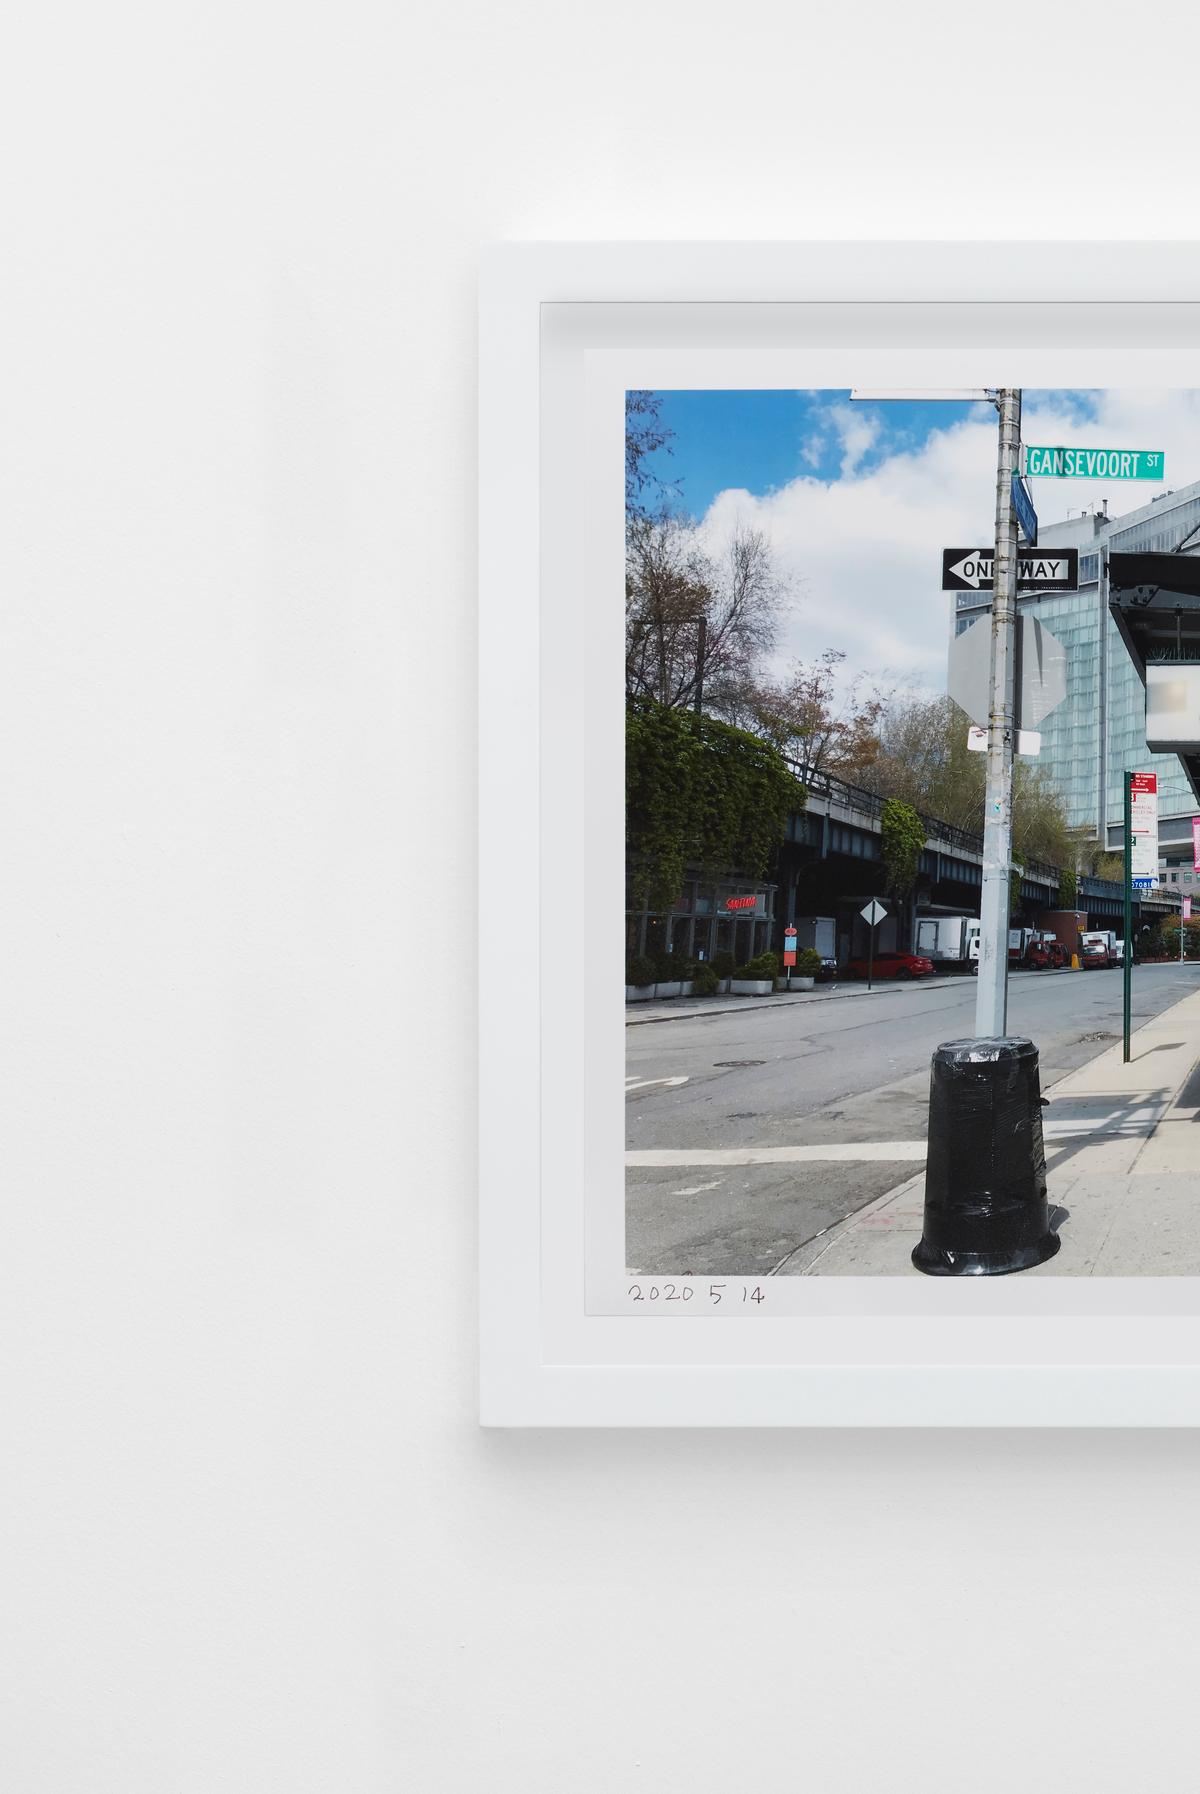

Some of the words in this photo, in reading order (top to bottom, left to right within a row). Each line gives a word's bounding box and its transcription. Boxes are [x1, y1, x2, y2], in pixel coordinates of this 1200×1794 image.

[1029, 448, 1140, 477] GANSEVOORT
[1146, 454, 1160, 467] ST
[1020, 561, 1061, 578] WAY
[627, 1284, 695, 1301] 2020
[709, 1284, 727, 1305] 5
[742, 1286, 766, 1304] 14
